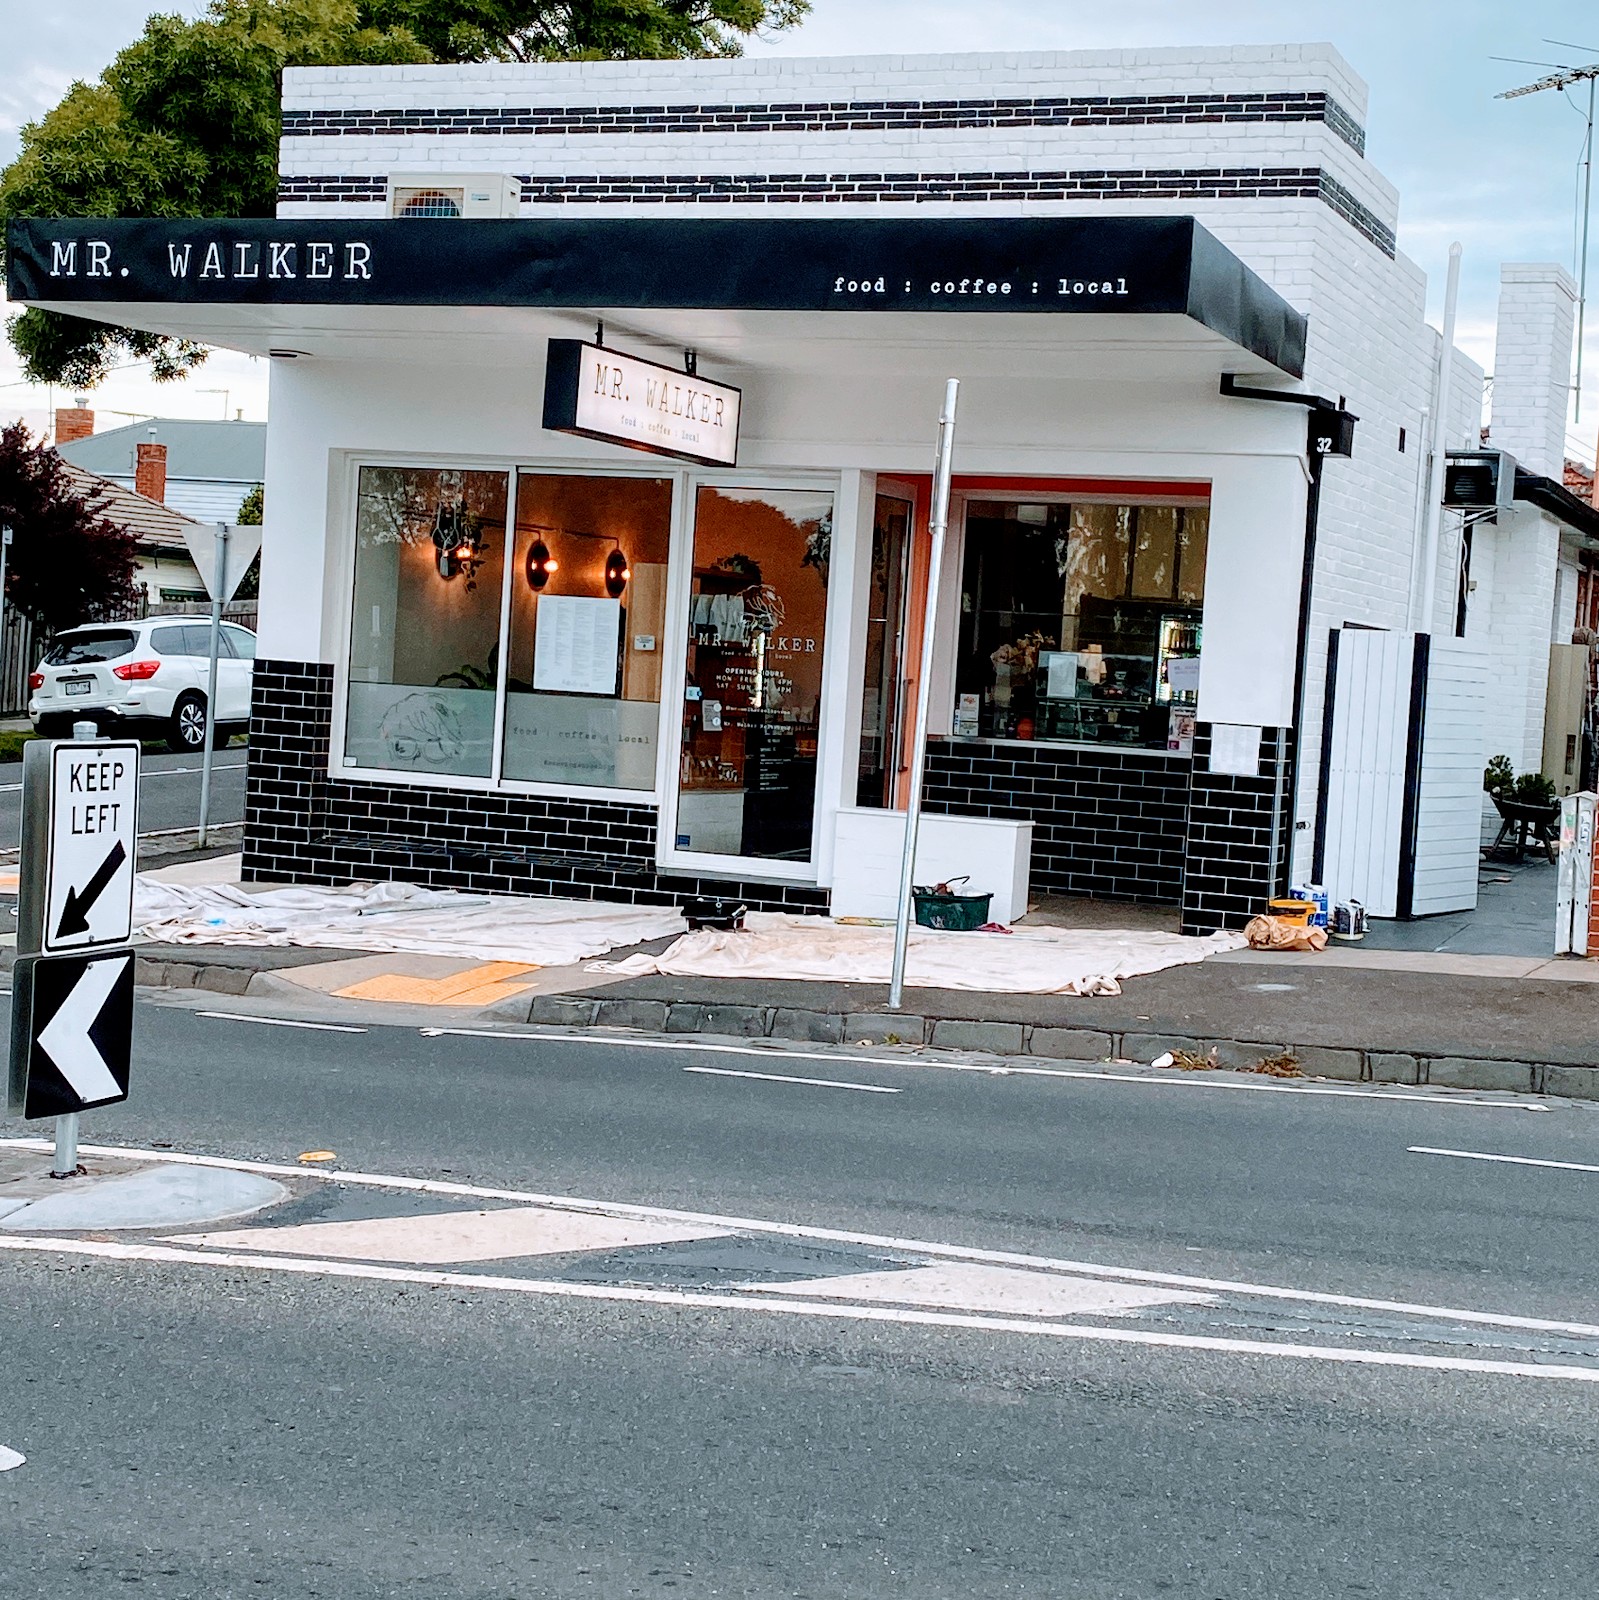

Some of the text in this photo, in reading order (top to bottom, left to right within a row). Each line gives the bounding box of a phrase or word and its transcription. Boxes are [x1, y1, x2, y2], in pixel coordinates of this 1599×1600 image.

[49, 241, 374, 280] MR. WALKER
[833, 277, 886, 293] food
[930, 278, 1012, 295] coffee
[1057, 278, 1129, 295] local
[594, 363, 725, 428] MR. WALKER
[620, 415, 637, 427] food
[648, 423, 671, 436] coffee
[681, 430, 700, 443] local
[1316, 437, 1332, 453] 32
[698, 632, 816, 653] MR. WLKER
[513, 727, 538, 736] food
[558, 730, 597, 740] coffee
[618, 734, 650, 744] local
[70, 762, 124, 793] KEEP
[71, 803, 121, 835] LEFT
